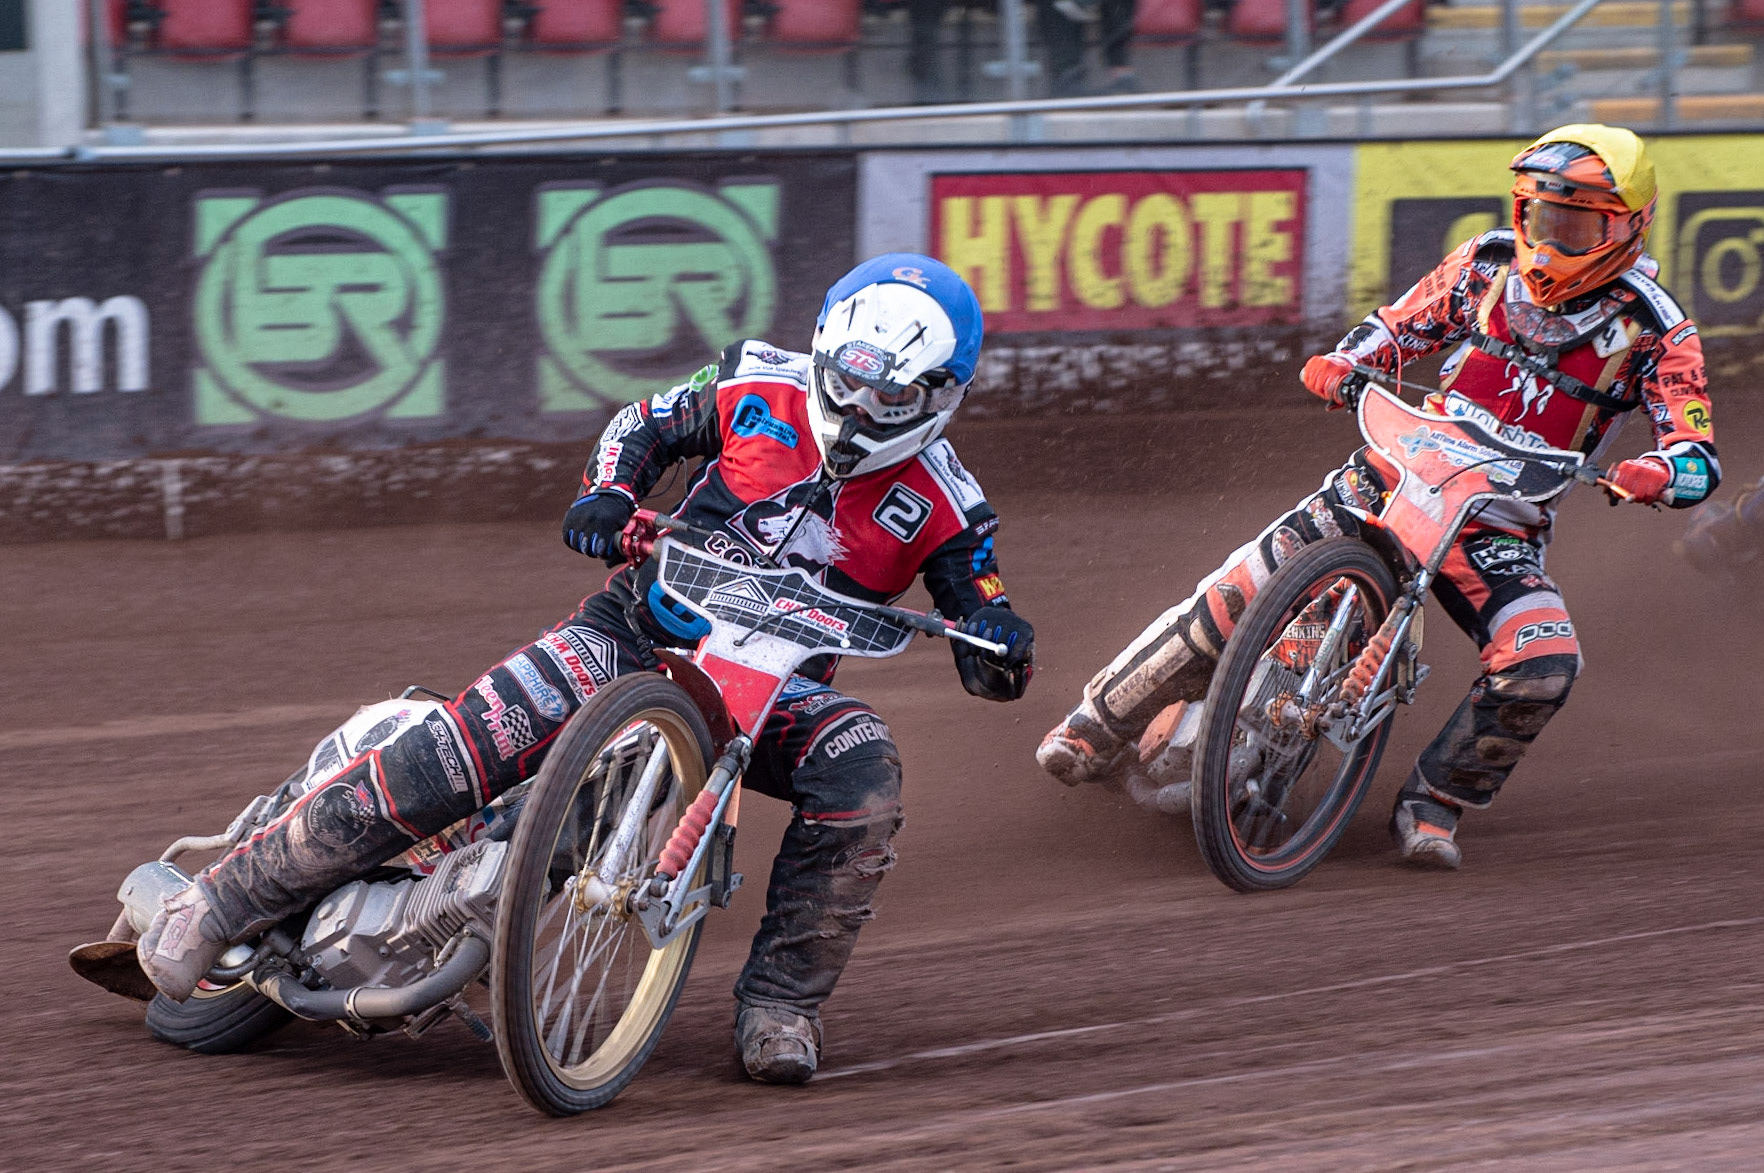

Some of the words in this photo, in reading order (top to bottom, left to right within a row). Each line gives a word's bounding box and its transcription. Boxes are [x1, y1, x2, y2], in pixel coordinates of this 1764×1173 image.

[941, 190, 1298, 313] HYCOTE
[841, 349, 881, 371] STS
[878, 490, 923, 538] 2
[807, 608, 846, 632] Doors
[478, 675, 506, 713] Teen
[512, 655, 555, 707] SAPPHIRE
[564, 655, 597, 697] Doors
